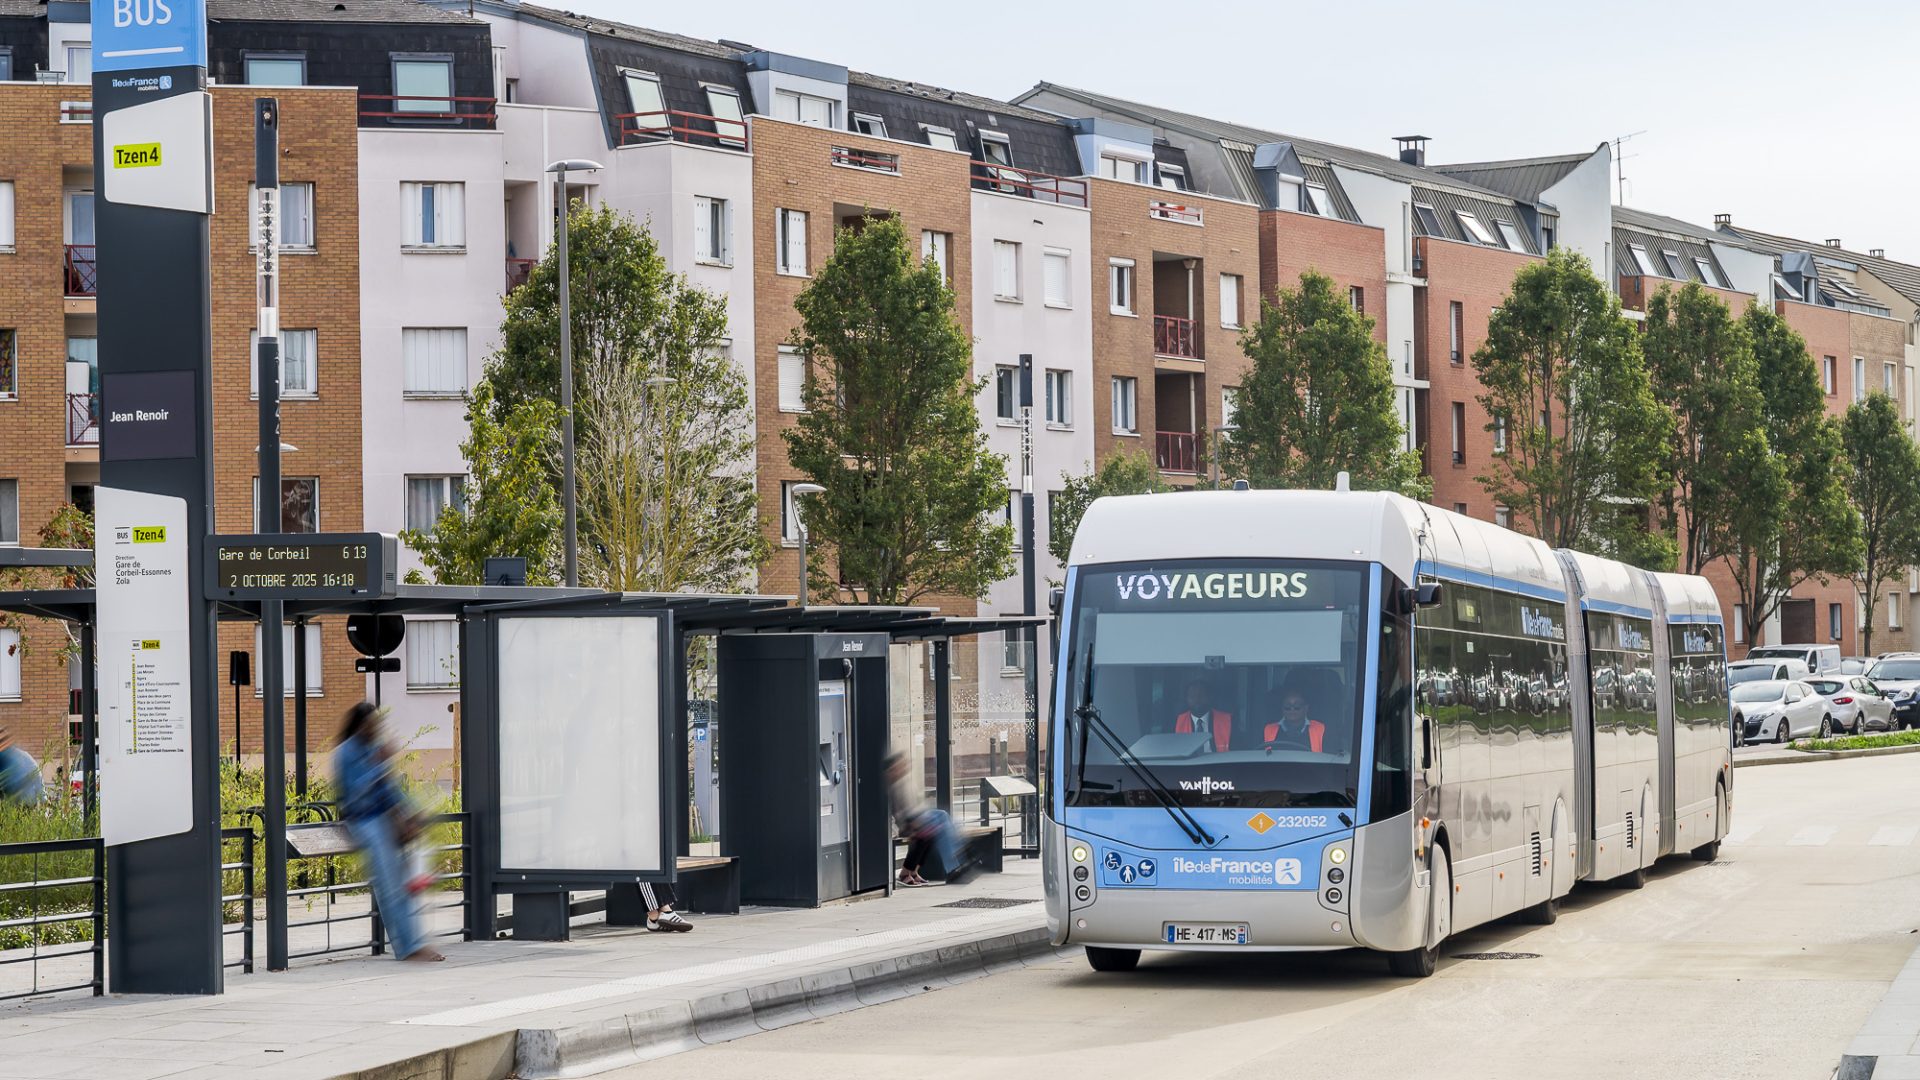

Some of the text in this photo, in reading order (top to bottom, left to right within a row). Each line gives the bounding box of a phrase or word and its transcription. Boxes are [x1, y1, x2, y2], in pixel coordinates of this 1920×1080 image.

[113, 0, 172, 28] BUS
[116, 147, 159, 165] Tzen 4
[110, 409, 169, 423] Jean Renoir
[134, 529, 164, 541] Tzen 4
[219, 545, 367, 561] Gare de Corbeil 6 13
[132, 560, 141, 568] de
[116, 568, 172, 576] Corbeil-Essonnes
[230, 573, 355, 587] 2 OCTOBRE 2025 16:18
[1116, 572, 1308, 600] VOYAGEURS
[1278, 815, 1327, 828] 232052
[1228, 875, 1273, 884] mobilités
